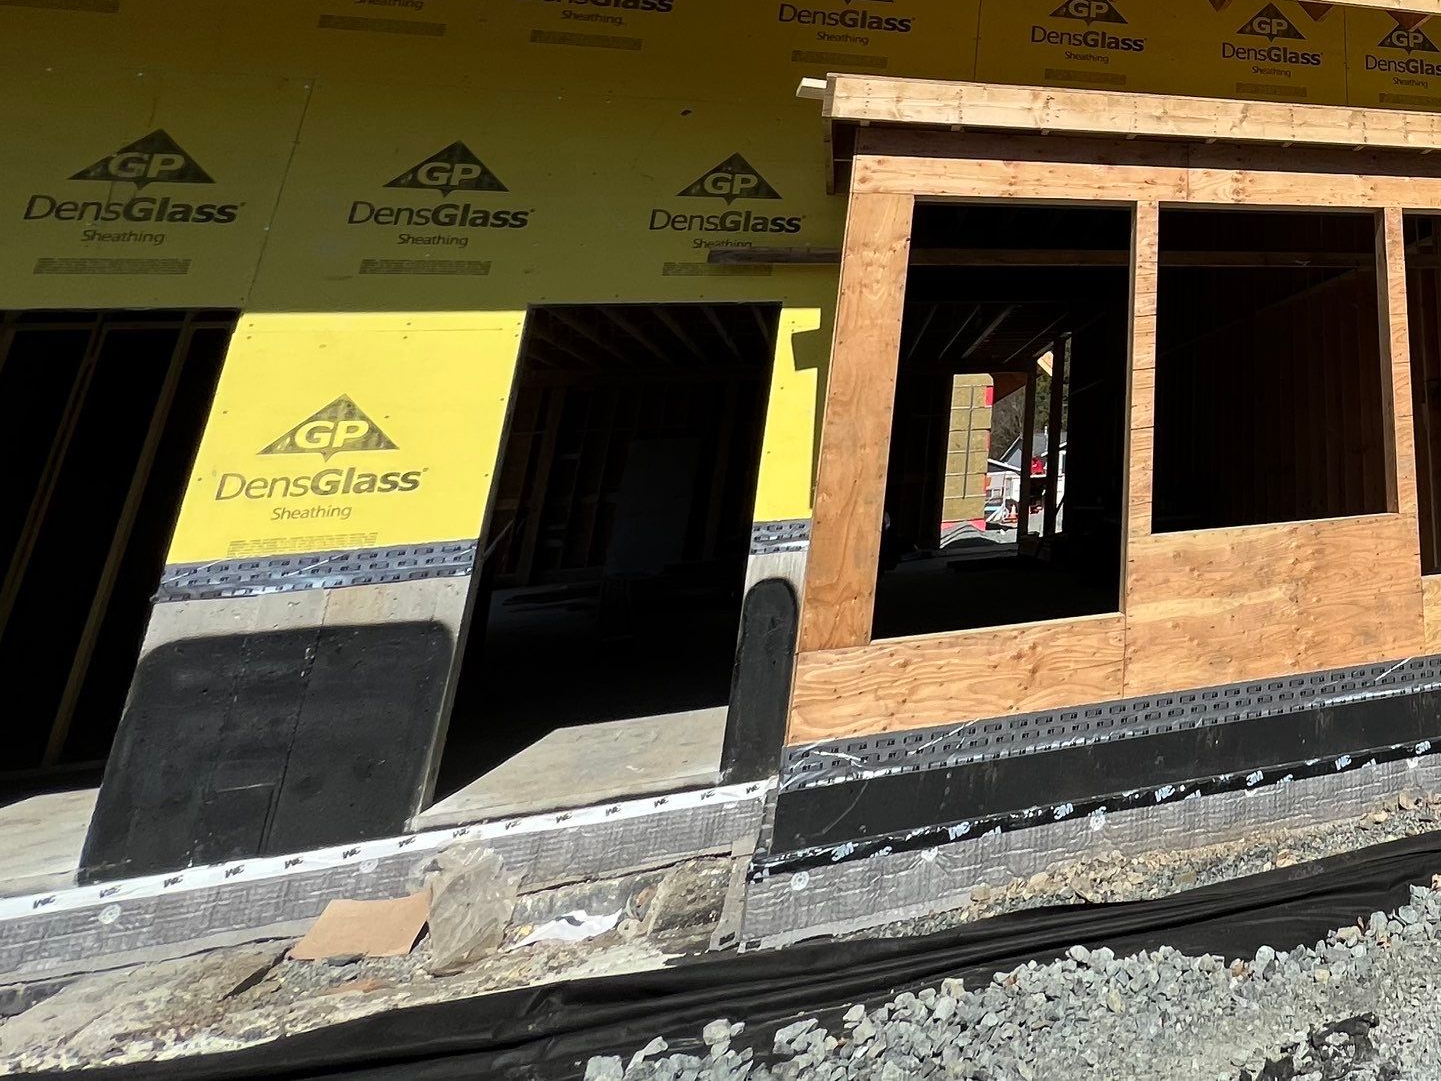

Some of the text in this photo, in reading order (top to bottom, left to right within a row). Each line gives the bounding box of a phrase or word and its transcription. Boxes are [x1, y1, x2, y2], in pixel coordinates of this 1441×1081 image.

[560, 9, 624, 26] Sheathing
[778, 3, 912, 33] DensGlass
[1068, 0, 1108, 18] GP
[1252, 17, 1288, 35] GP
[816, 30, 870, 46] Sheathing
[1030, 25, 1144, 52] DensGlass
[1391, 30, 1424, 47] GP
[1064, 51, 1109, 64] Sheathing
[1221, 42, 1321, 66] DensGlass
[109, 152, 184, 177] GP
[417, 162, 482, 186] GP
[704, 173, 758, 194] GP
[23, 194, 239, 223] DensGlass
[347, 200, 530, 228] DensGlass
[649, 208, 801, 232] DensGlass
[81, 230, 165, 245] Sheathing
[398, 232, 468, 247] Sheathing
[295, 420, 370, 449] GP
[215, 467, 421, 501] DensGlass
[271, 504, 352, 521] Sheathing
[1246, 770, 1264, 786] 3M
[1053, 803, 1074, 819] 3M
[831, 842, 854, 861] 3M
